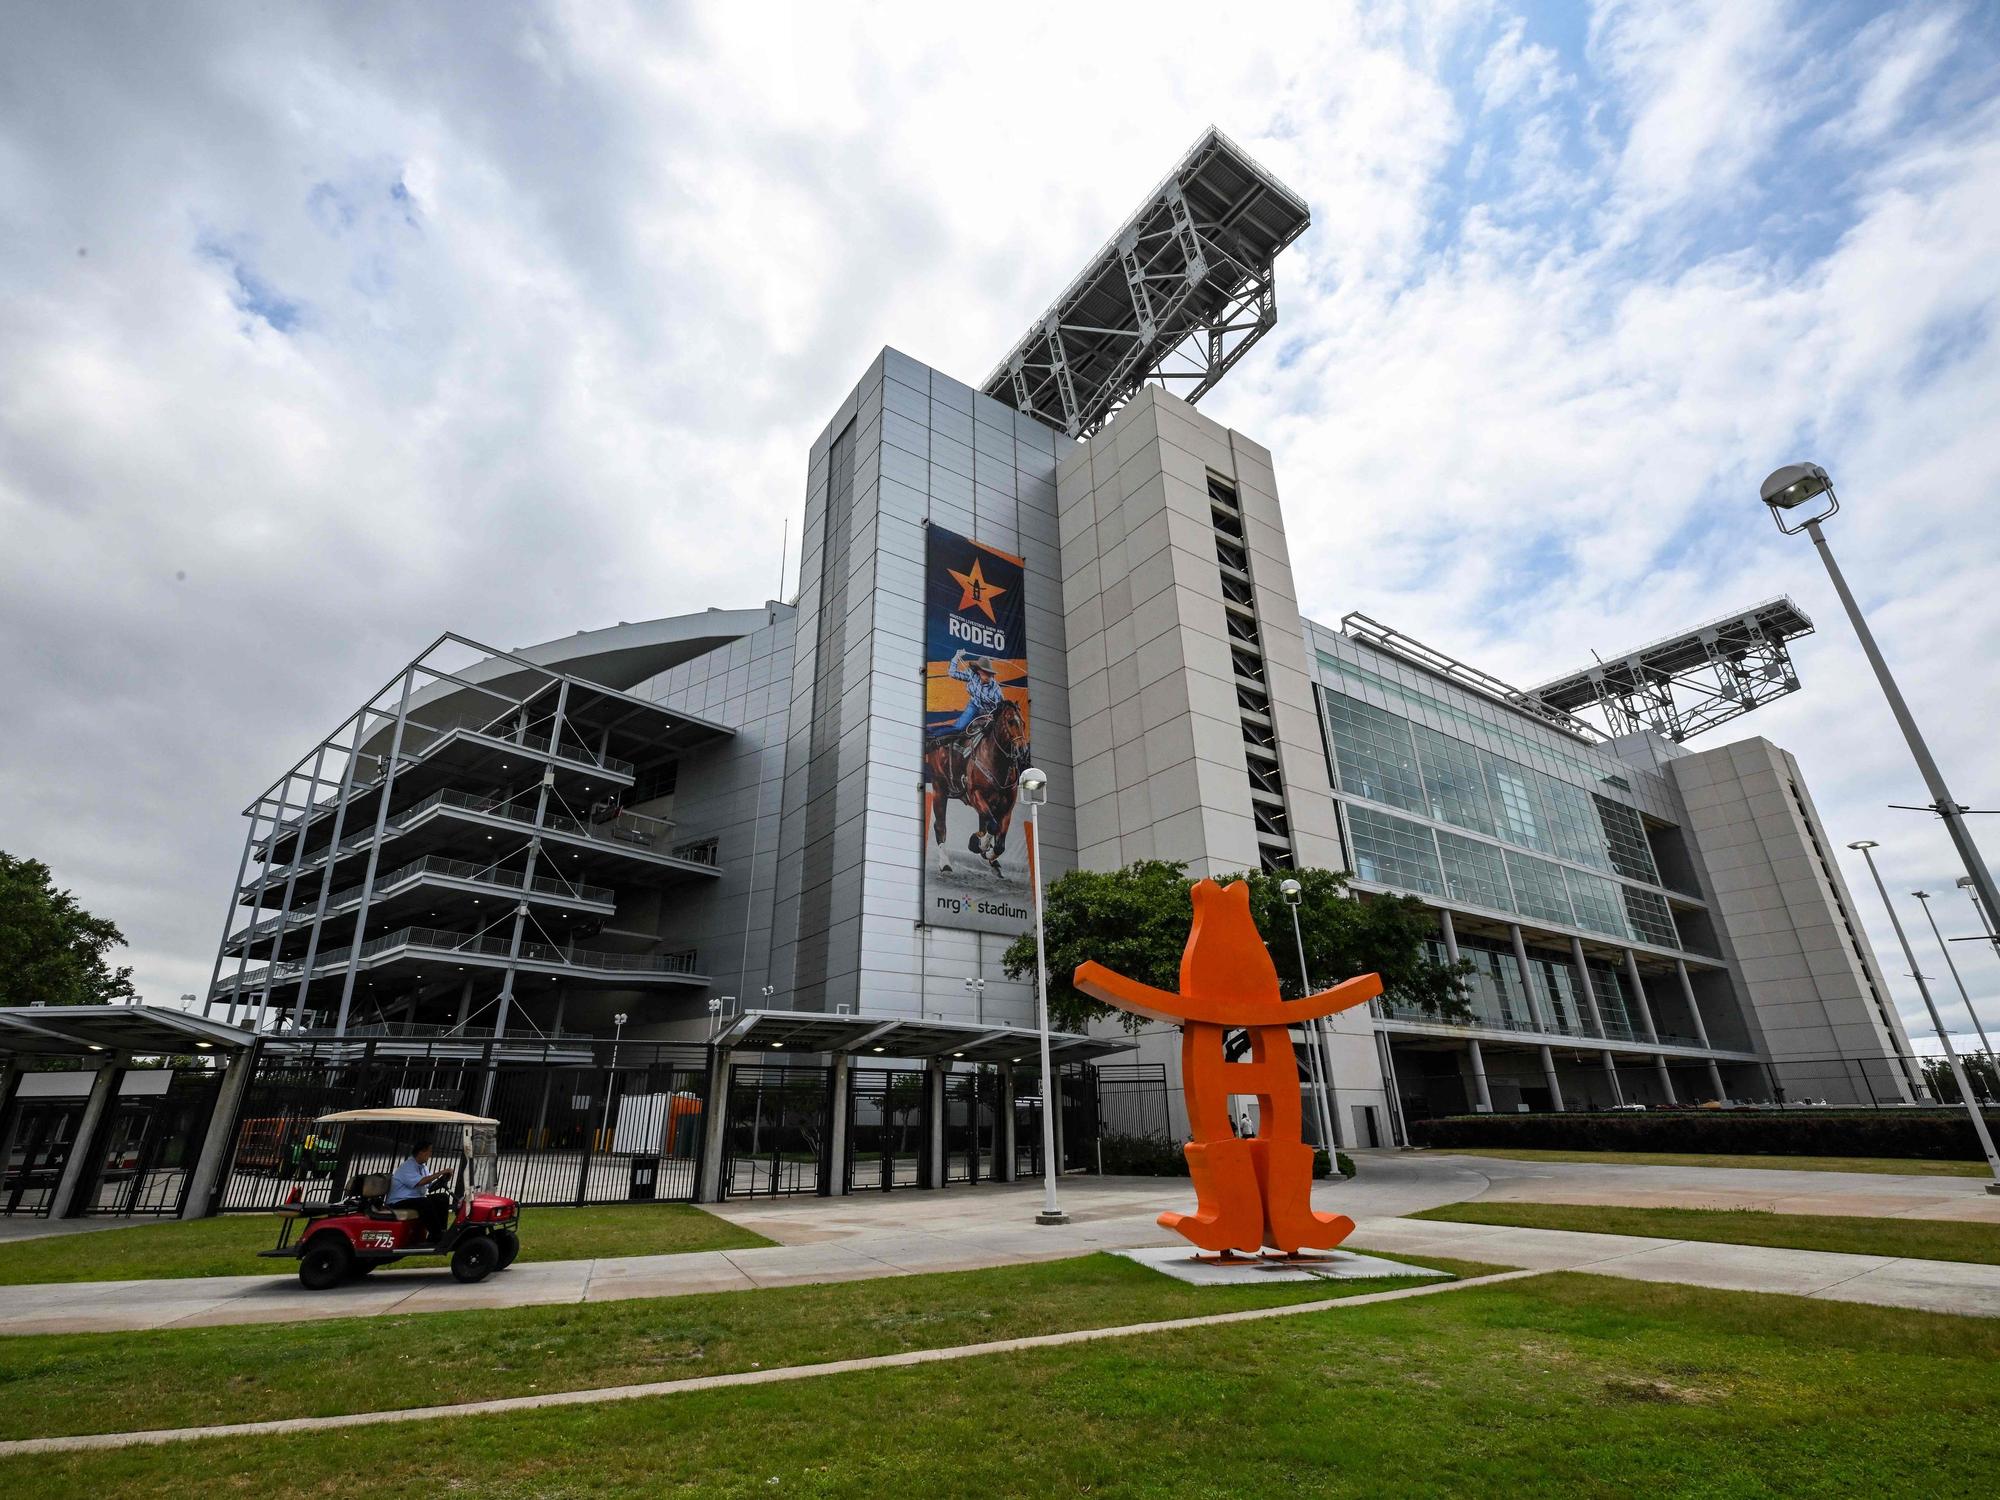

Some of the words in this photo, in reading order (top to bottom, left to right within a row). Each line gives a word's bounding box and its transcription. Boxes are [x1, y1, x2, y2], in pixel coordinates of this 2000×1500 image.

[949, 617, 1005, 651] RODEO
[937, 897, 960, 914] nrg
[978, 901, 1027, 919] stadium
[374, 1236, 395, 1248] 725
